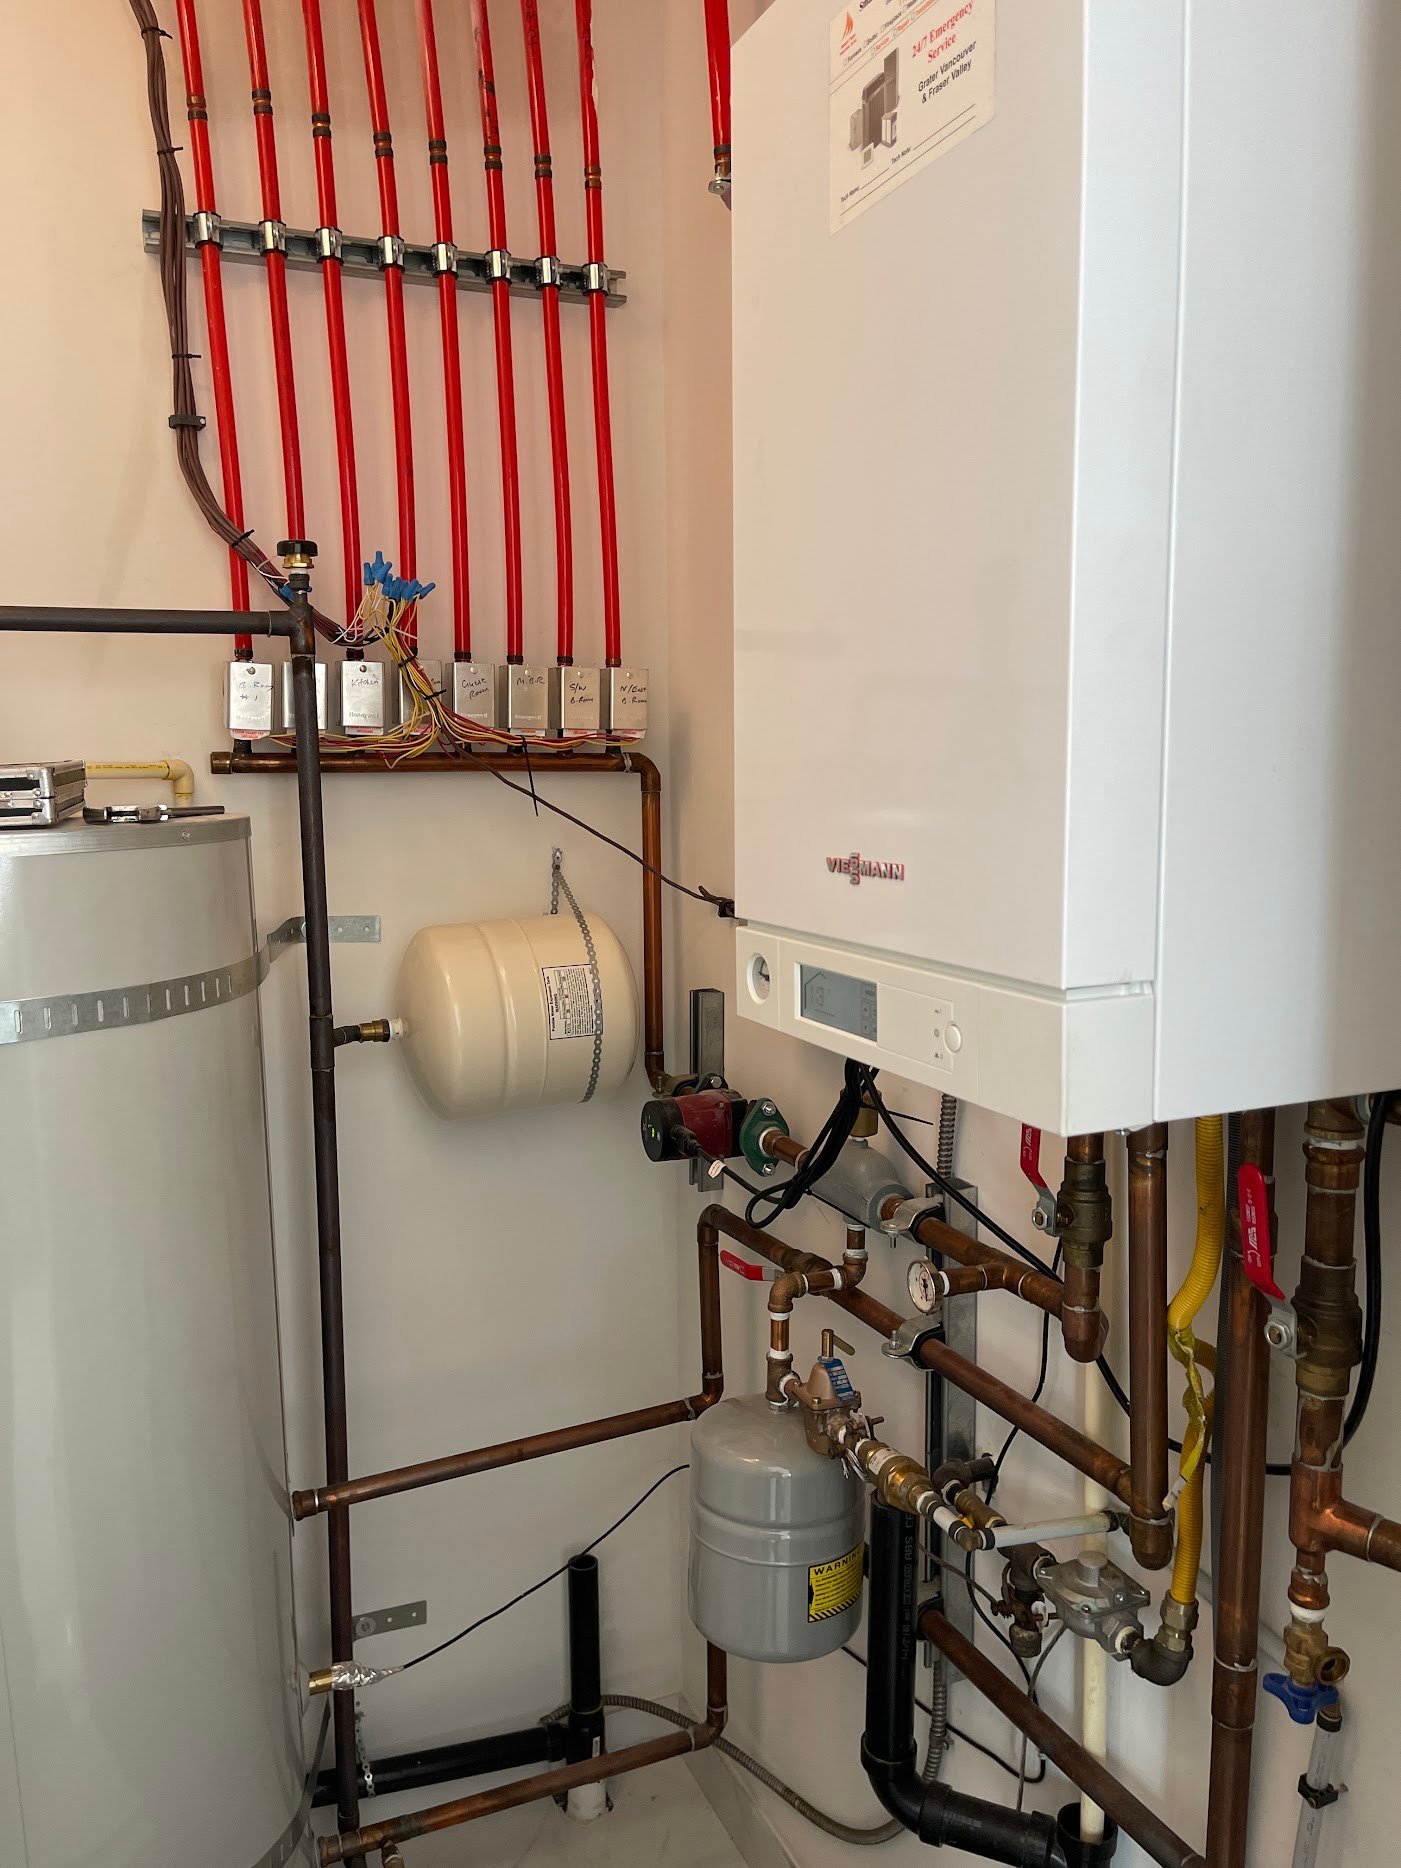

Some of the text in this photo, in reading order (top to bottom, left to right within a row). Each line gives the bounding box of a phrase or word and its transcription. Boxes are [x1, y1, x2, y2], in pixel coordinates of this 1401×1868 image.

[912, 36, 928, 59] 24/7
[929, 1, 973, 43] Emergency
[928, 34, 956, 63] Service
[918, 41, 976, 92] Grater Vancouver
[922, 60, 972, 104] & Fraser Valley
[826, 852, 904, 885] VIESSMANN
[904, 1536, 914, 1560] ABS
